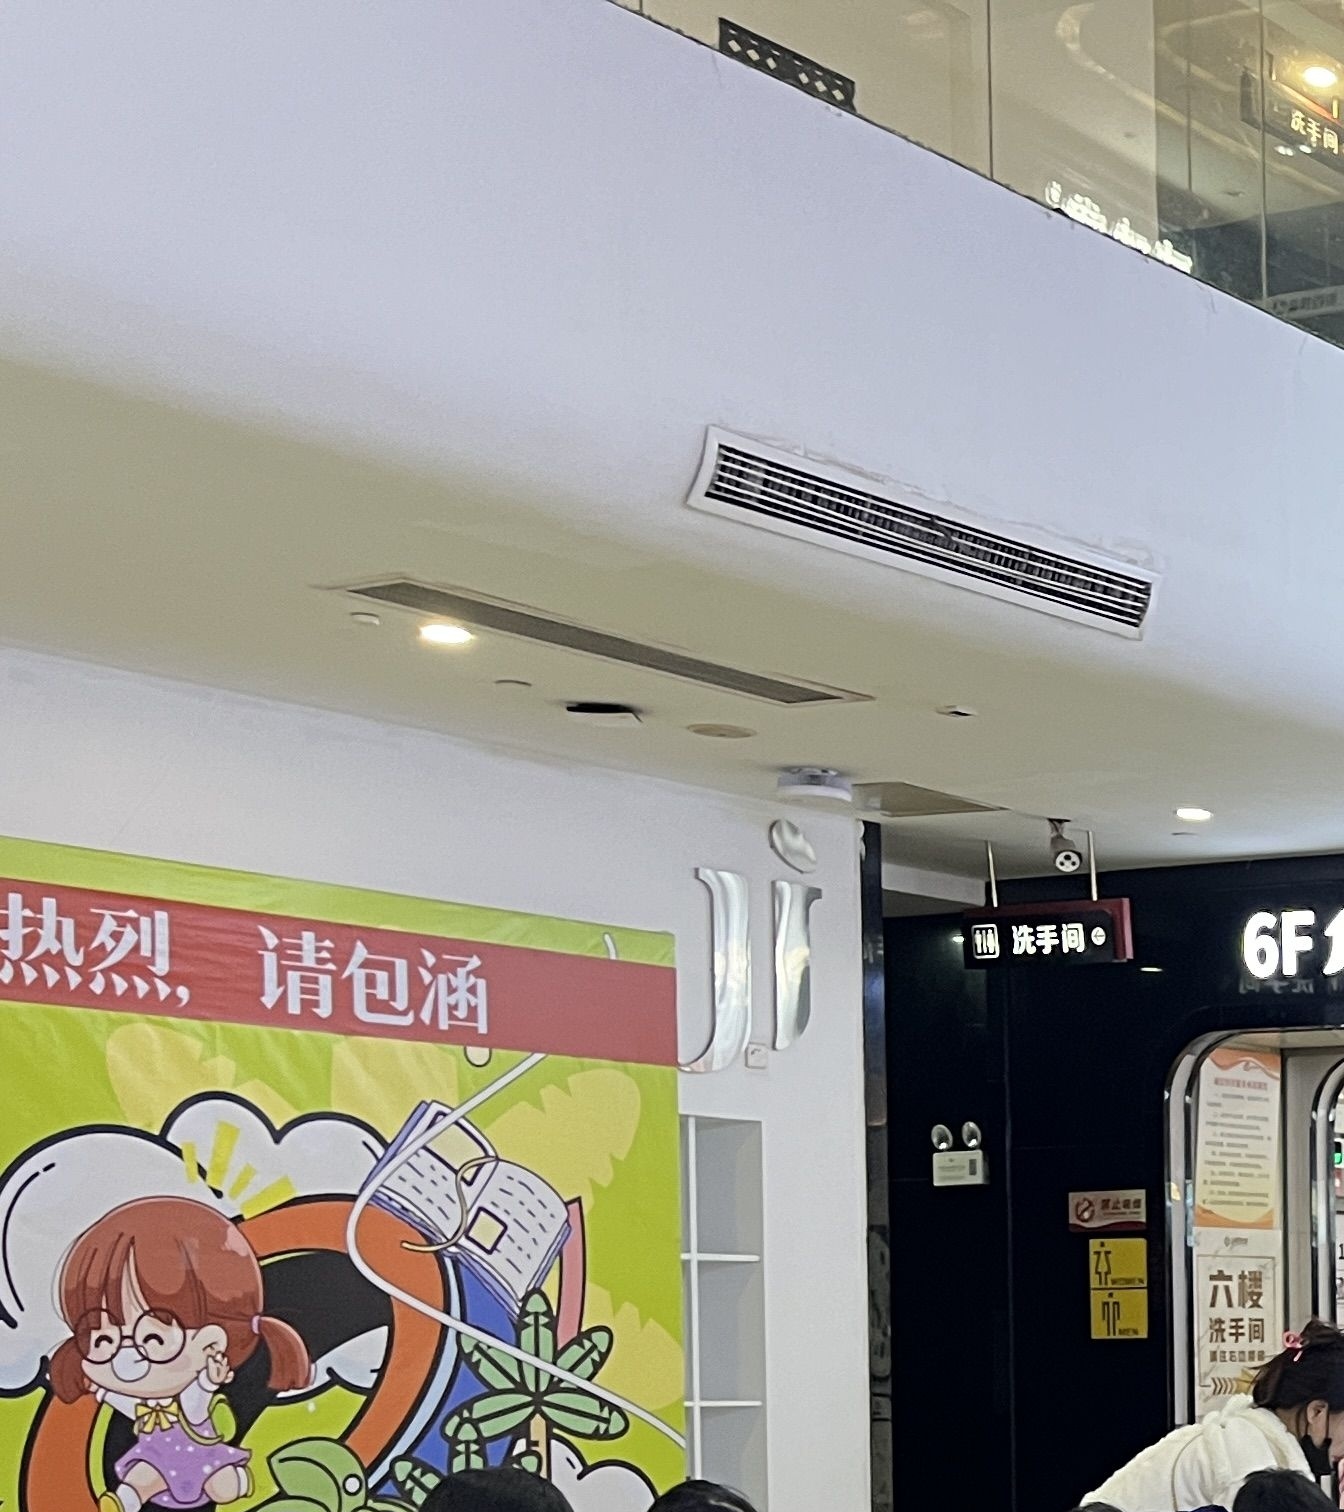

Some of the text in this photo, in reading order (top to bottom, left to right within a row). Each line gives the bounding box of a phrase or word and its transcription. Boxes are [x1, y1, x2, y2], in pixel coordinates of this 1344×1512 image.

[1011, 921, 1085, 956] 洗手间
[1243, 909, 1316, 980] 6F
[257, 922, 492, 1036] 请包涵
[1208, 1269, 1264, 1309] 六楼
[1208, 1317, 1265, 1344] 洗手间
